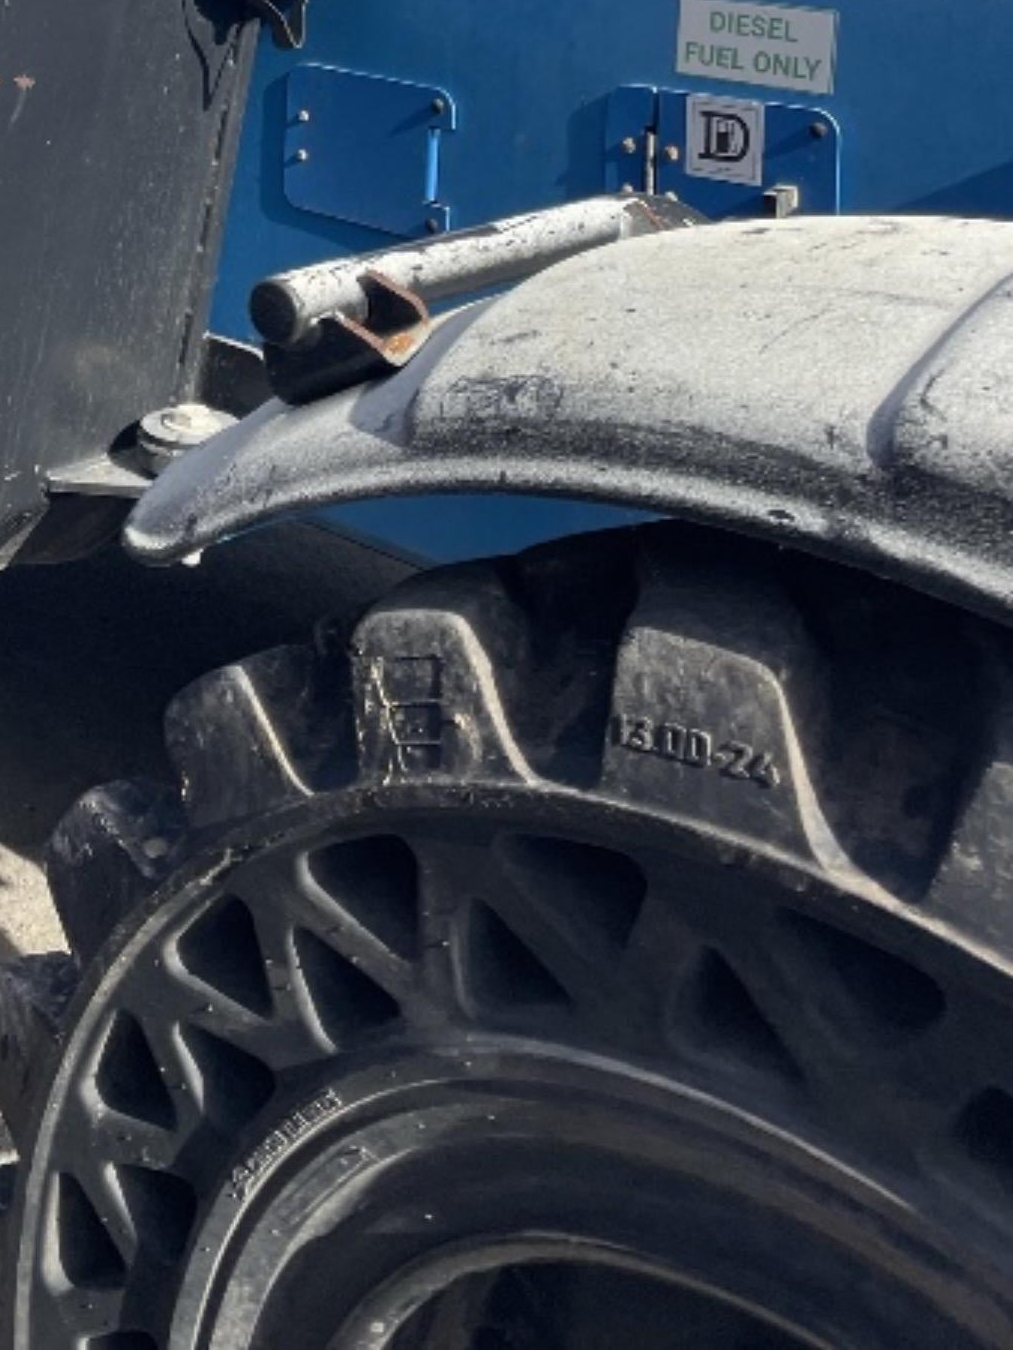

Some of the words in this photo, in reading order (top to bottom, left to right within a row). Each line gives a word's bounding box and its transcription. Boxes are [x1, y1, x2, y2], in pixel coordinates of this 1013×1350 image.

[709, 10, 799, 43] DIESEL
[685, 41, 745, 70] FUEL
[752, 50, 823, 82] ONLY
